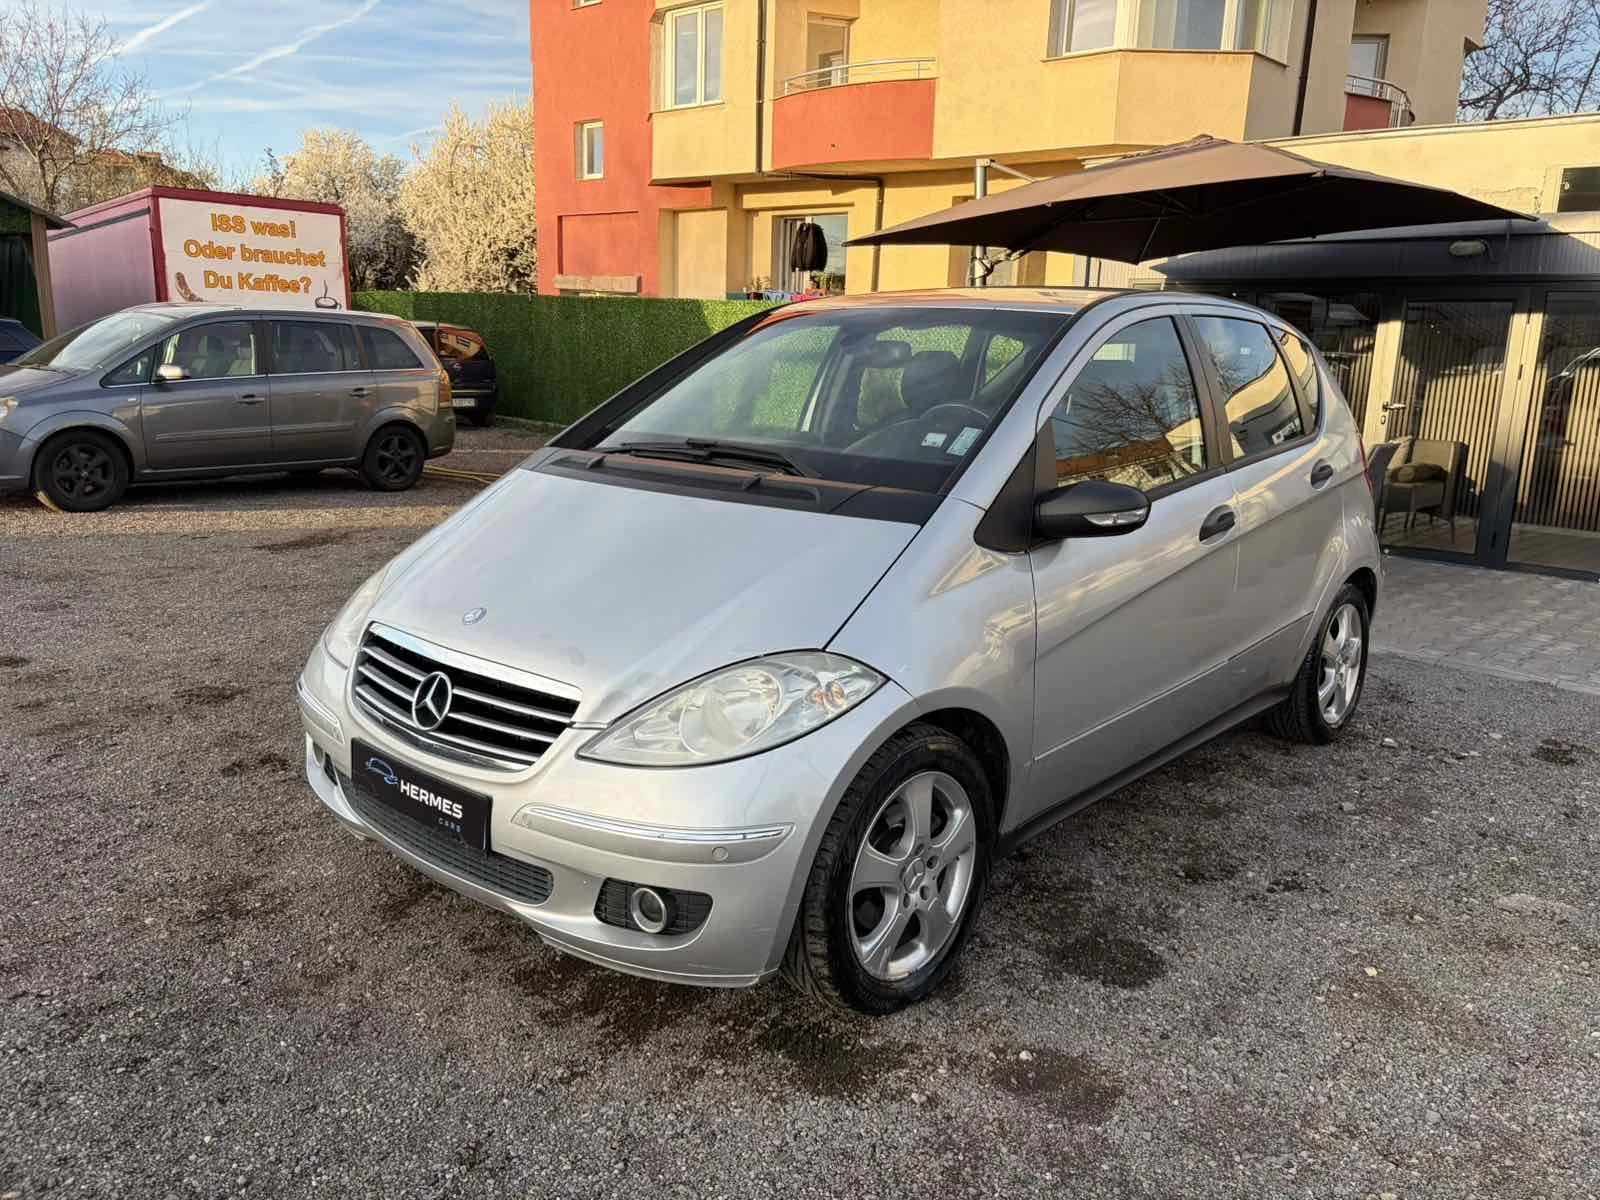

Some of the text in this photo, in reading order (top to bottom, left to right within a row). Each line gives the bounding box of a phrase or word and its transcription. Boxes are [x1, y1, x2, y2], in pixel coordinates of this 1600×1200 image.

[250, 220, 296, 238] was!
[184, 239, 326, 267] Oder brauchst
[204, 270, 311, 293] Du Kaffee?
[400, 779, 463, 819] HERMES
